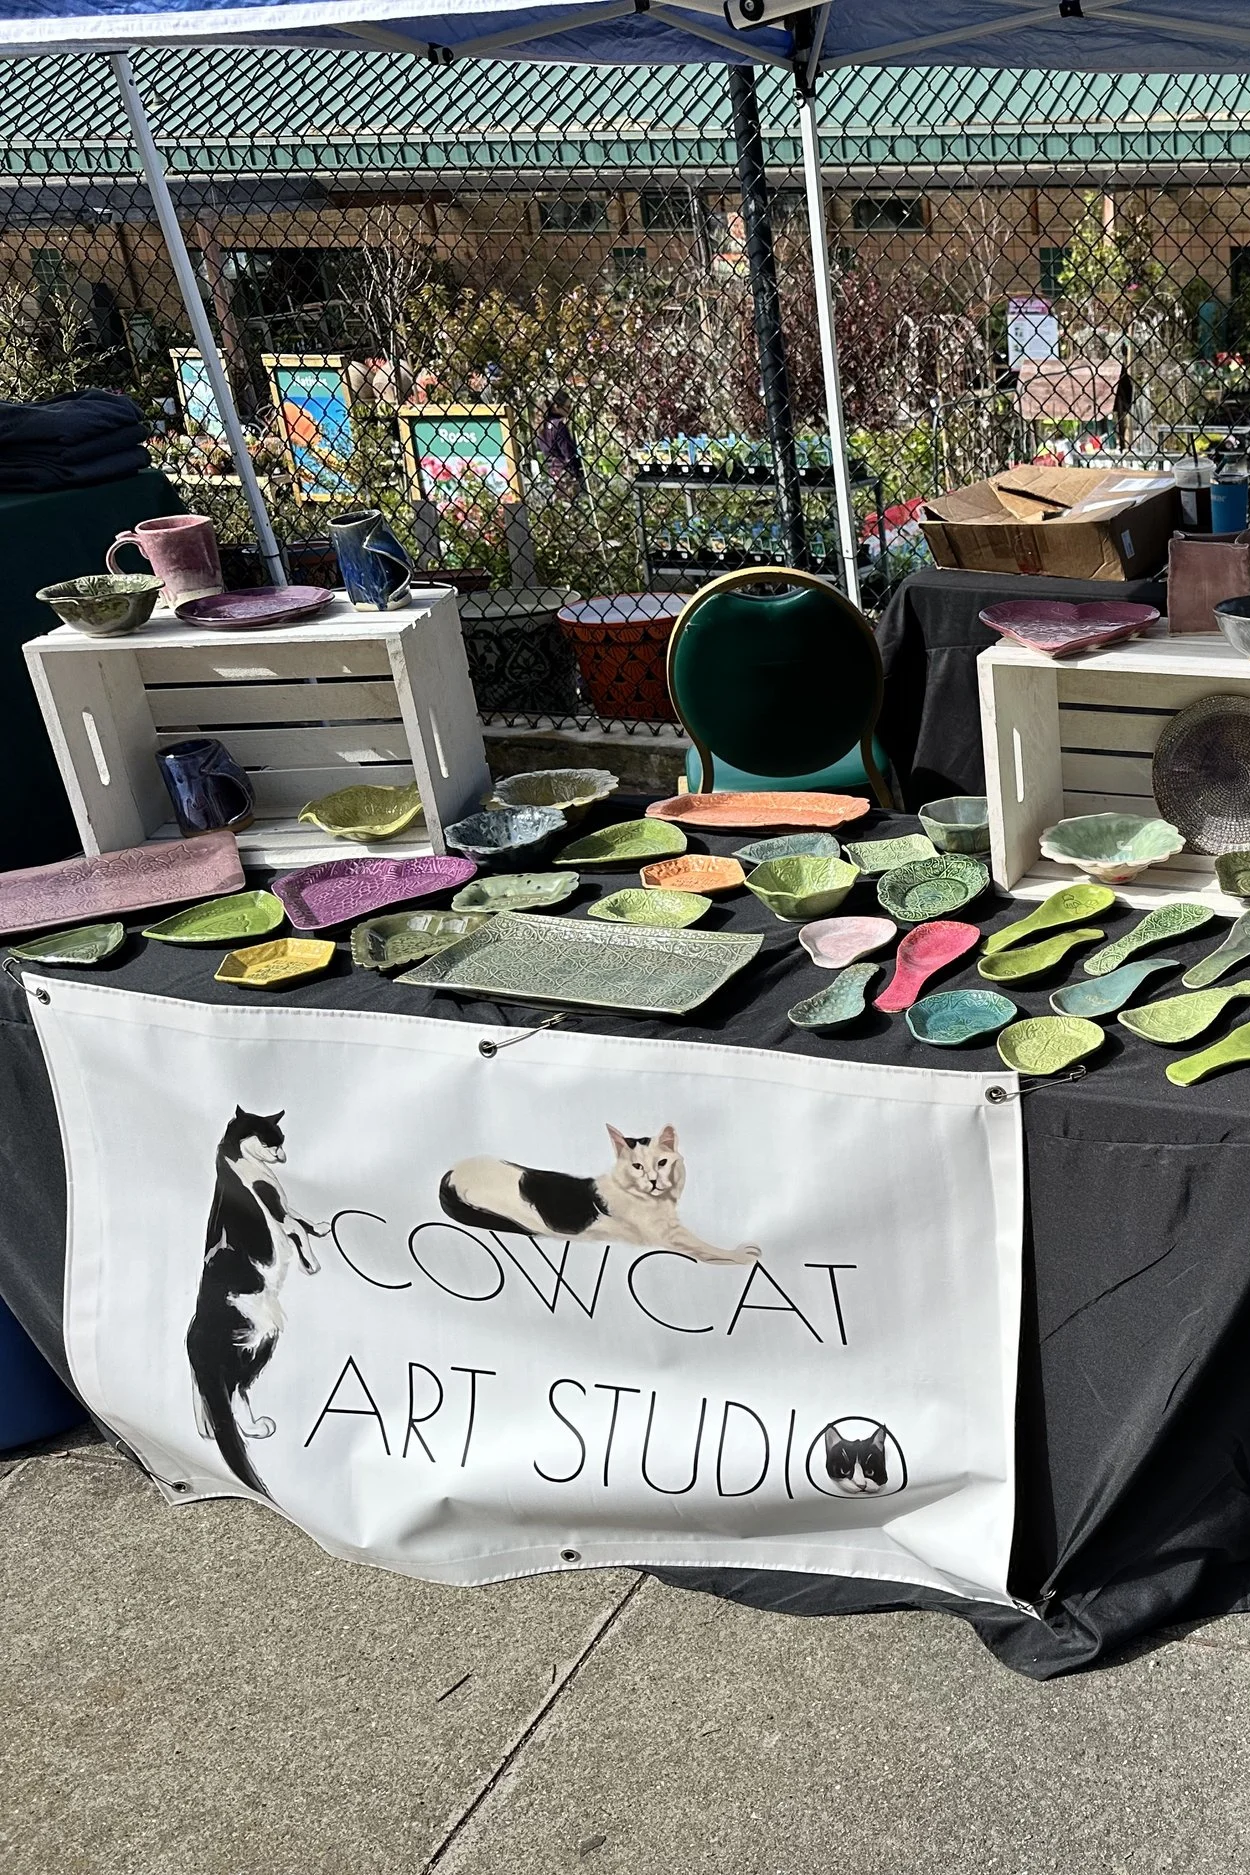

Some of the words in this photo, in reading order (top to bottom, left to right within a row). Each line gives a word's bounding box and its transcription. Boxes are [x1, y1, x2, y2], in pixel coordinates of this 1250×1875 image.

[438, 428, 478, 443] Roses
[331, 1209, 857, 1345] COWCAT
[305, 1355, 496, 1468] ART
[534, 1377, 907, 1499] STUDIO
